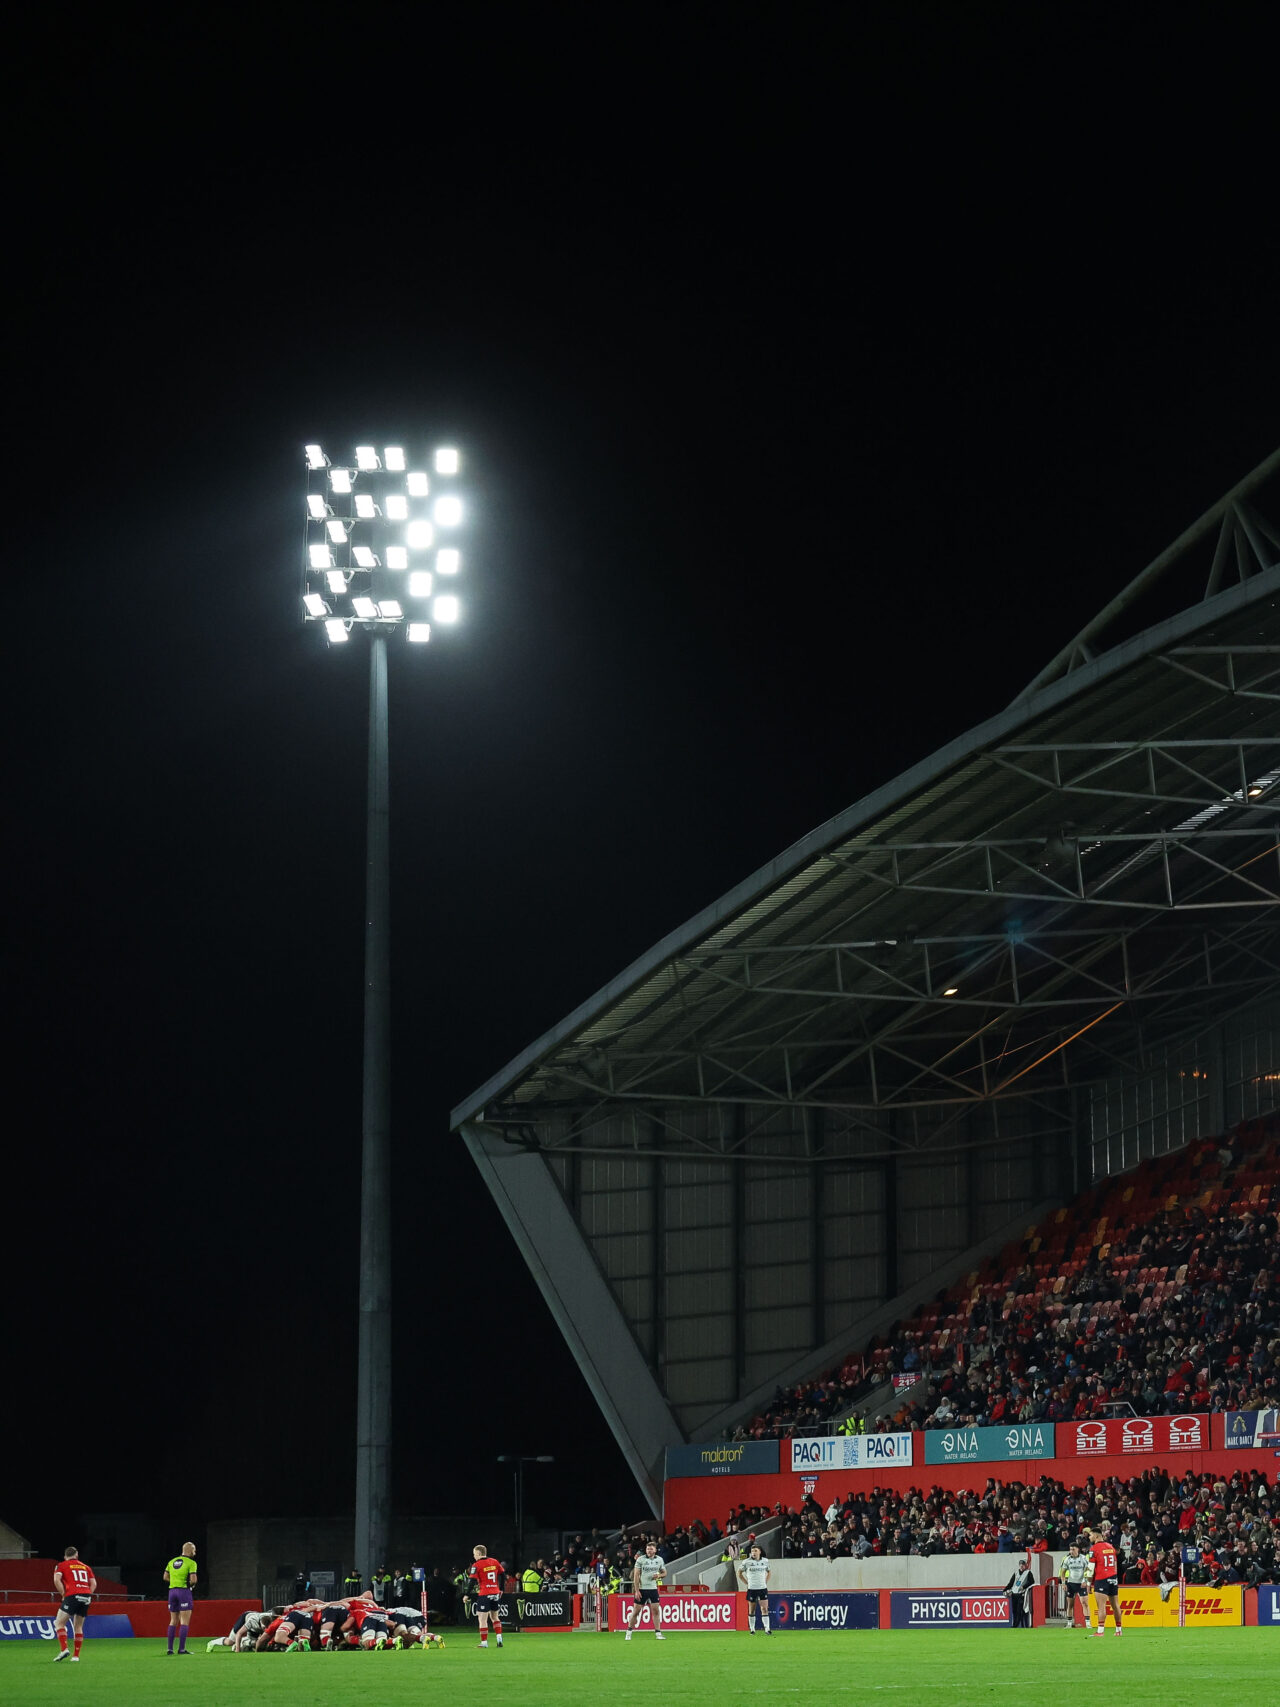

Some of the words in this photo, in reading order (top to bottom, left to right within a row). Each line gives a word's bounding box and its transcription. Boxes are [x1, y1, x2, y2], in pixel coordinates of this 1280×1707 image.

[899, 1379, 916, 1387] 212
[1077, 1437, 1106, 1448] STS
[1123, 1434, 1153, 1445] STS
[1170, 1432, 1201, 1443] STS
[804, 1484, 815, 1493] 107
[1103, 1555, 1116, 1567] 13
[72, 1570, 89, 1582] 10
[487, 1571, 497, 1583] 9
[525, 1602, 563, 1616] GUINNESS
[793, 1600, 848, 1626] Pinergy
[912, 1602, 960, 1619] PHYSIO
